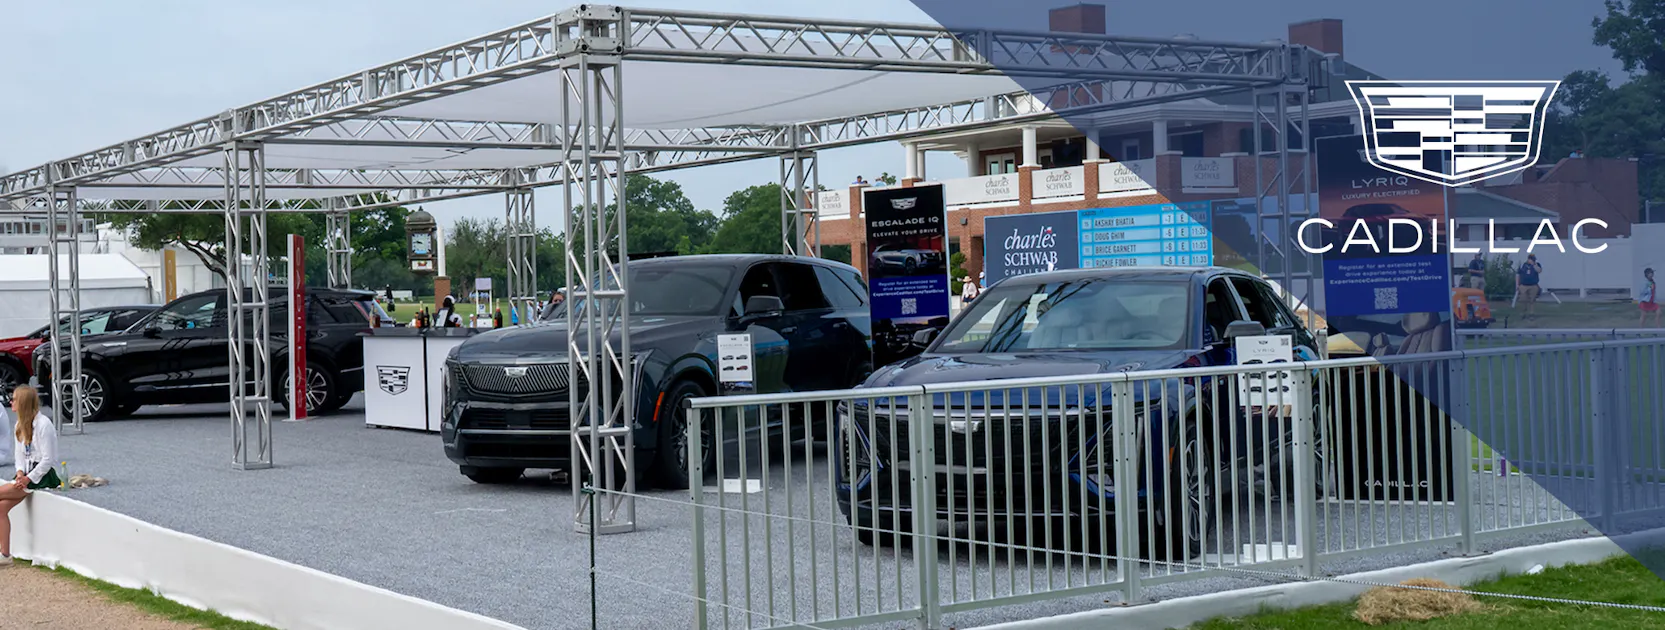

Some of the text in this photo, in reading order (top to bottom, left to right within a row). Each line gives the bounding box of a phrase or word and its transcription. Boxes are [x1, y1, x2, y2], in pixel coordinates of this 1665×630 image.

[1352, 176, 1408, 189] LYRIQ
[1373, 189, 1420, 198] ELECTRIFIED
[872, 217, 925, 227] ESCALADE
[1095, 219, 1114, 227] AKSHAY
[1116, 218, 1134, 226] BHATIA
[1180, 214, 1184, 222] E
[1004, 226, 1056, 250] charles
[1095, 232, 1109, 240] DOUG
[1181, 228, 1184, 236] E
[1096, 246, 1112, 254] BRICE
[1113, 245, 1136, 253] GARNETT
[1182, 242, 1185, 250] E
[1192, 240, 1206, 249] 11:33
[1004, 251, 1058, 266] SCHWAB
[1096, 259, 1114, 268] RICKIE
[1115, 258, 1137, 267] FOWLER
[1330, 275, 1442, 284] ExperienceCadillac.com/TestDrive
